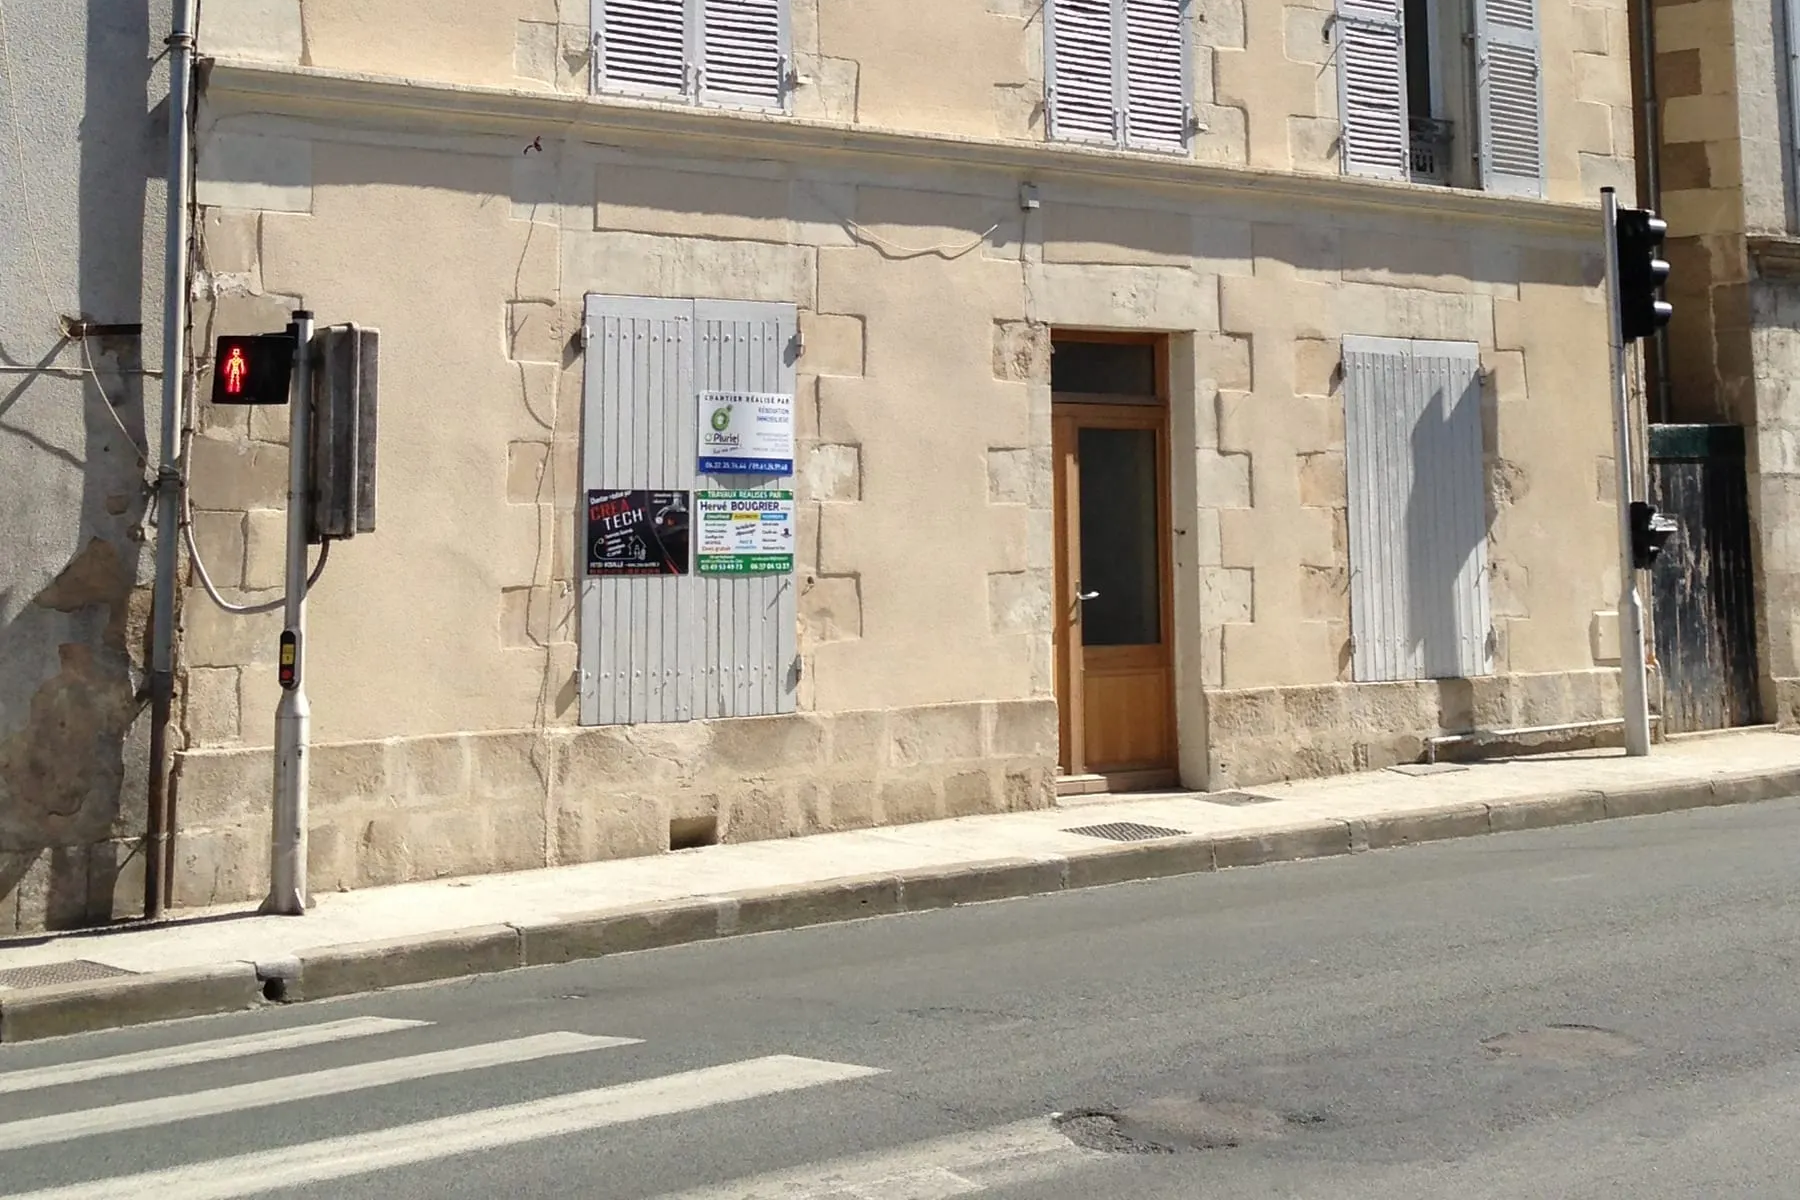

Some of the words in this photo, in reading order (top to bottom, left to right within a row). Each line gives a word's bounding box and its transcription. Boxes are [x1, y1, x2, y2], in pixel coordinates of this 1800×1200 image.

[700, 501, 727, 511] Hervé
[731, 501, 779, 511] BOUGRIER
[603, 508, 643, 530] TECH
